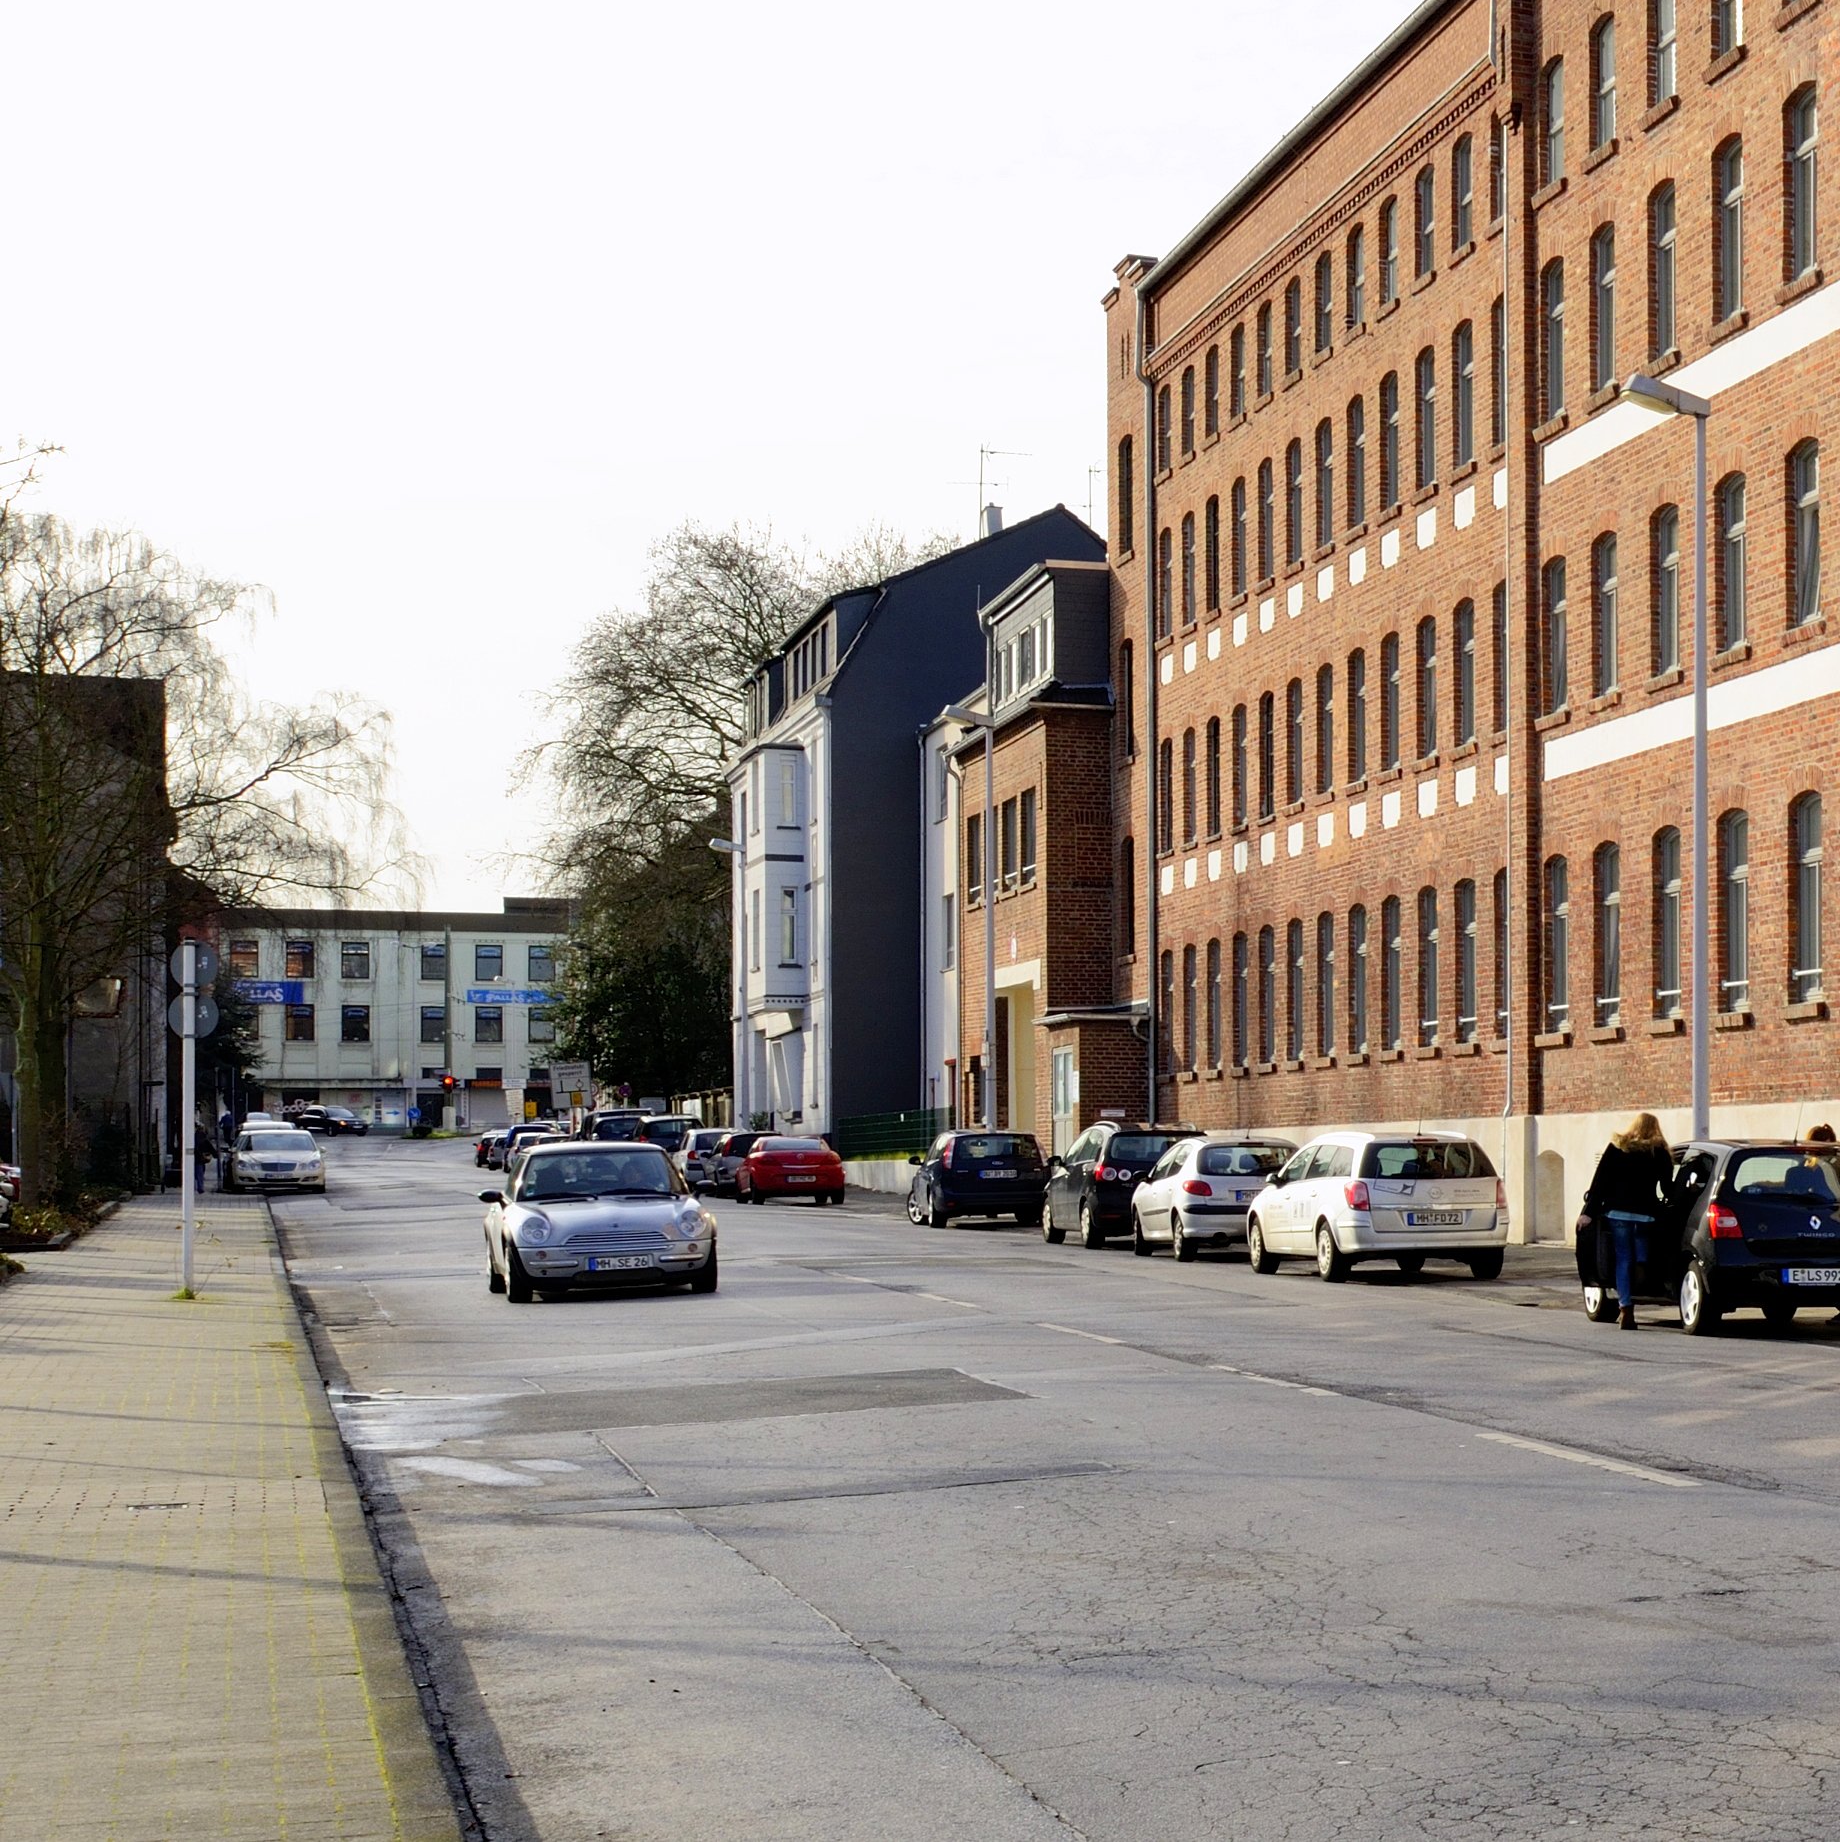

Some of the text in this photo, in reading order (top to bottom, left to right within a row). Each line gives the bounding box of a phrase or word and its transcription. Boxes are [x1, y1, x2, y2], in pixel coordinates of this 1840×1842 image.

[1416, 1213, 1429, 1222] MH
[1447, 1213, 1459, 1222] 72
[596, 1257, 648, 1269] MH SE 26
[1792, 1270, 1800, 1282] E
[1807, 1270, 1822, 1282] LS
